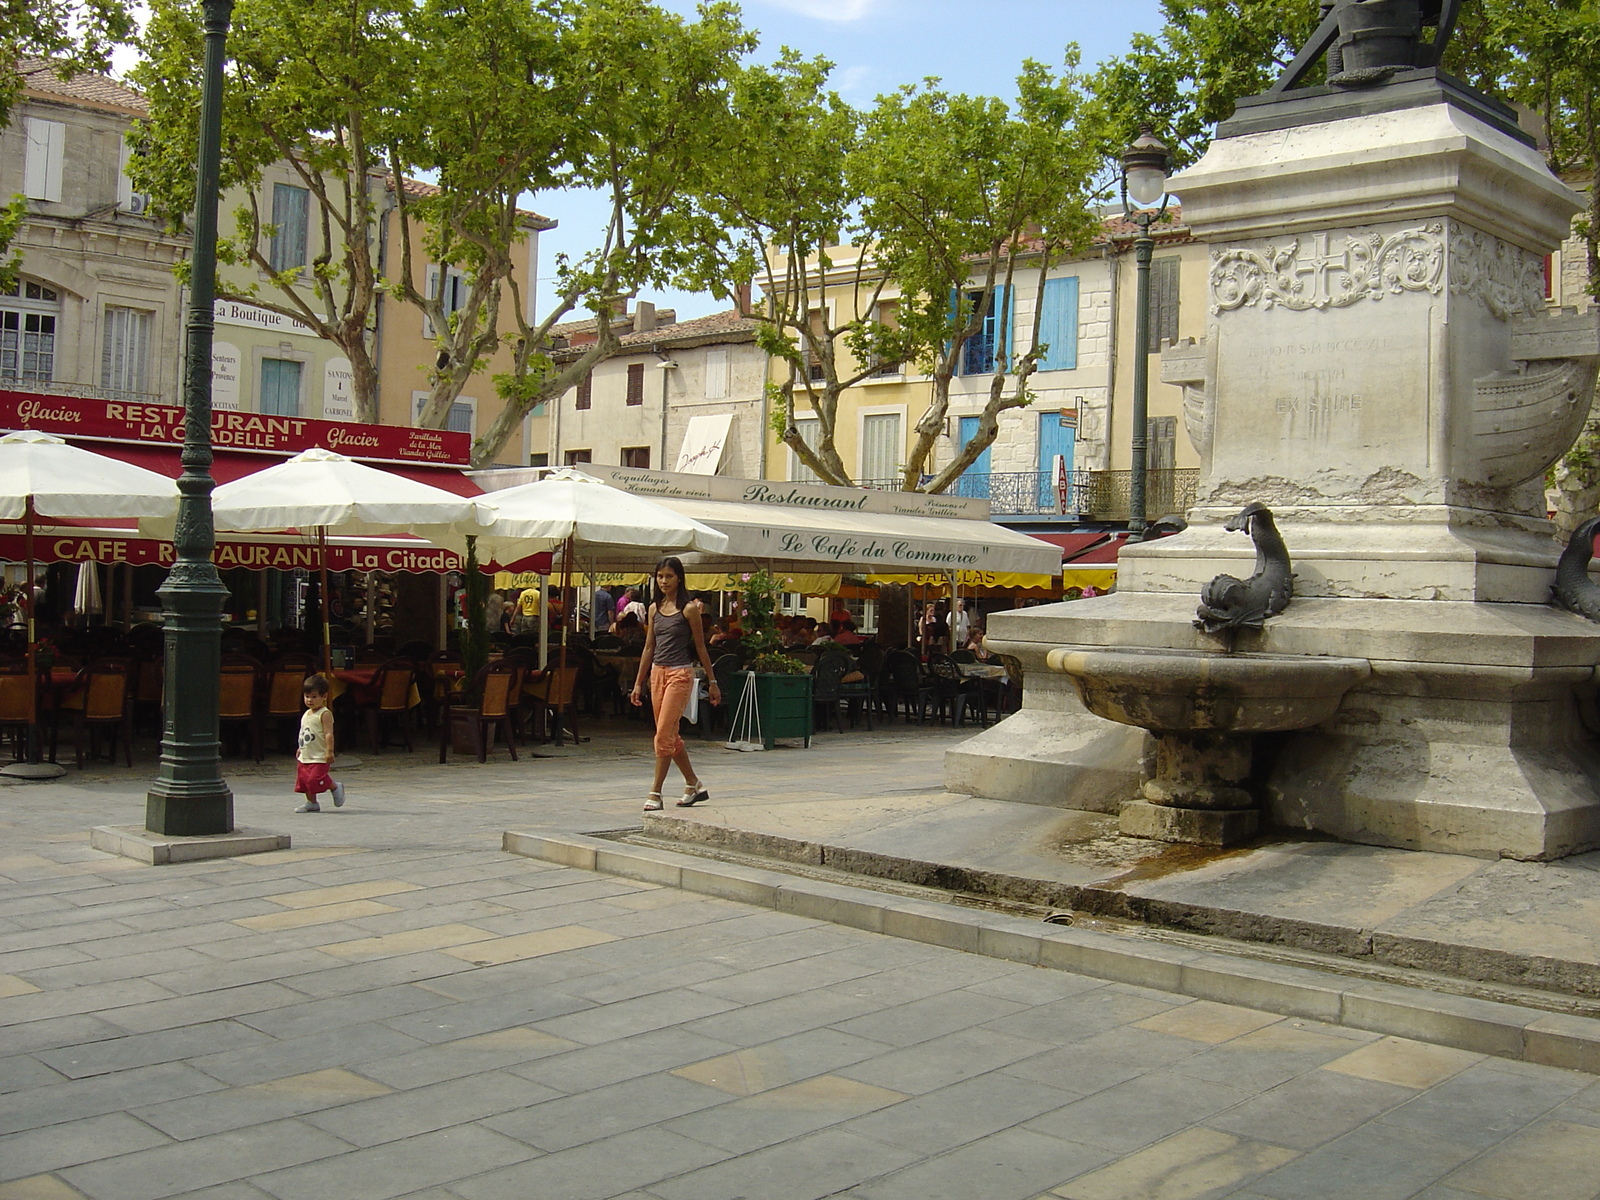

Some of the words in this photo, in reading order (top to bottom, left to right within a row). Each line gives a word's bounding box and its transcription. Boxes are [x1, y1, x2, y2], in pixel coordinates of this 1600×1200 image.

[231, 305, 282, 326] Boutique
[17, 400, 82, 423] Glacier
[106, 403, 307, 436] RESTURANT
[171, 426, 276, 448] CADELLE
[327, 427, 380, 449] Glacier
[409, 440, 417, 448] de
[417, 441, 426, 449] la
[398, 447, 425, 457] Viandes
[611, 471, 670, 486] Coquillages
[625, 483, 669, 494] Homard
[669, 487, 681, 495] du
[685, 489, 712, 498] vivier
[743, 484, 868, 510] Restaurant
[893, 505, 925, 515] Viandes
[53, 540, 127, 560] CAFE
[158, 543, 327, 566] RTAURANT
[352, 549, 379, 568] La
[778, 533, 806, 552] Le
[811, 535, 860, 560] Café
[861, 541, 888, 558] du
[892, 541, 978, 564] Commerce
